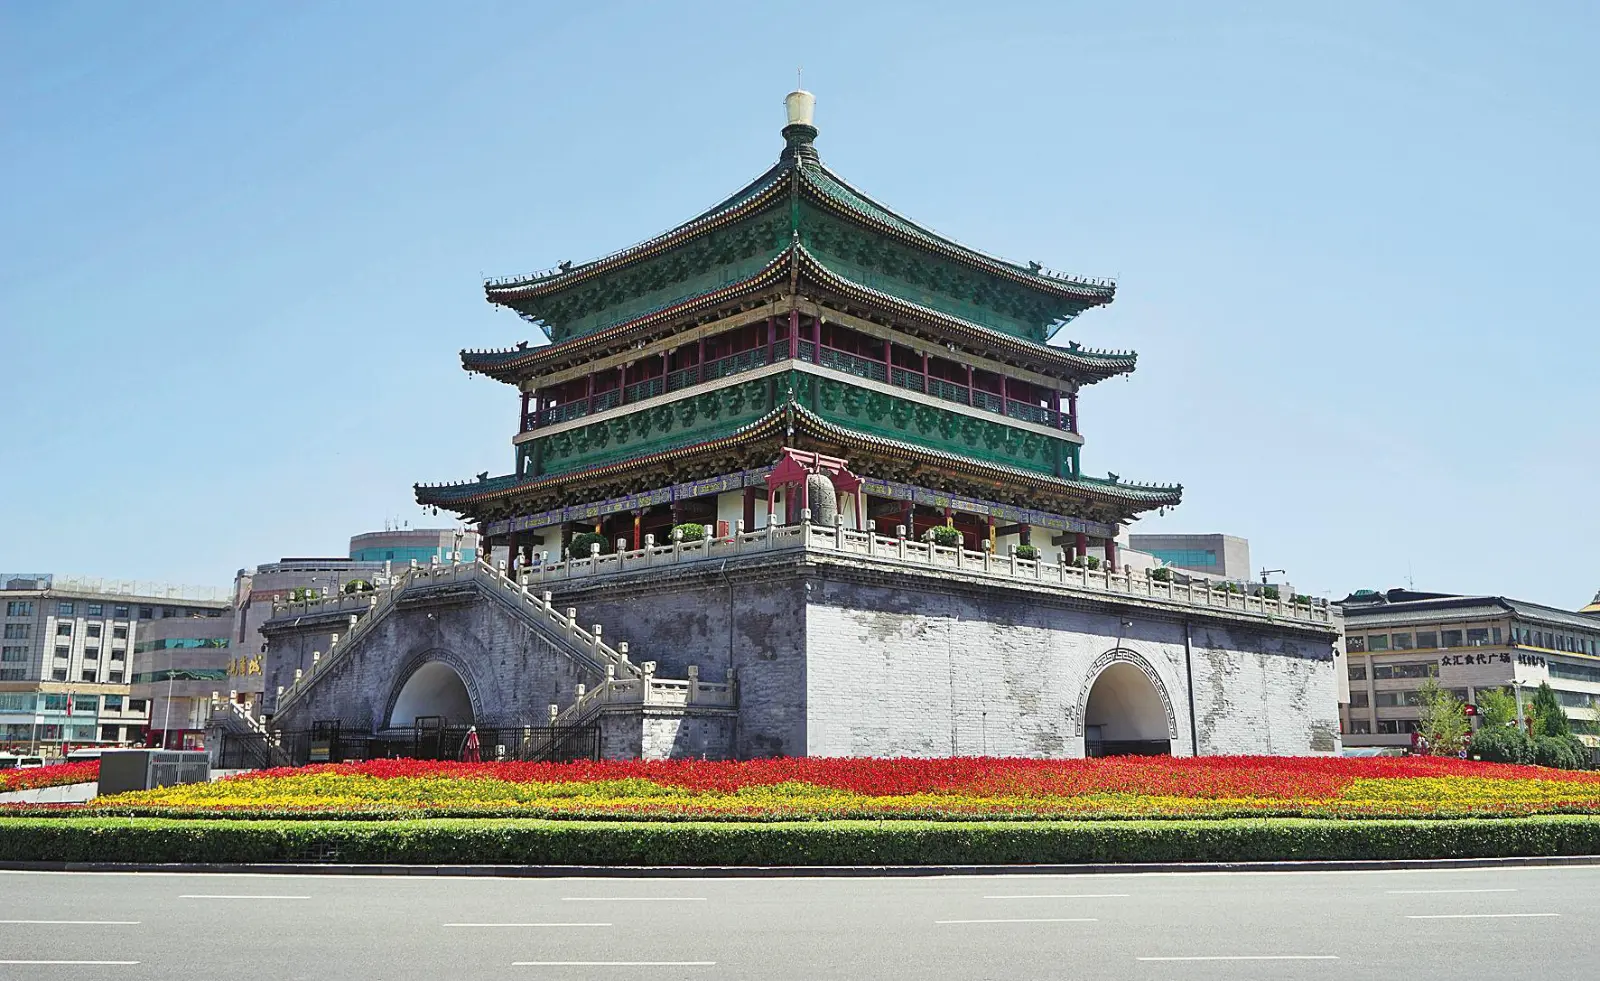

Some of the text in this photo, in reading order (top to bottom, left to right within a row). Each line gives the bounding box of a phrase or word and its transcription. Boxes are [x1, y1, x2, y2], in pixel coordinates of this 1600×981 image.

[1441, 653, 1511, 666] 众汇食代广场
